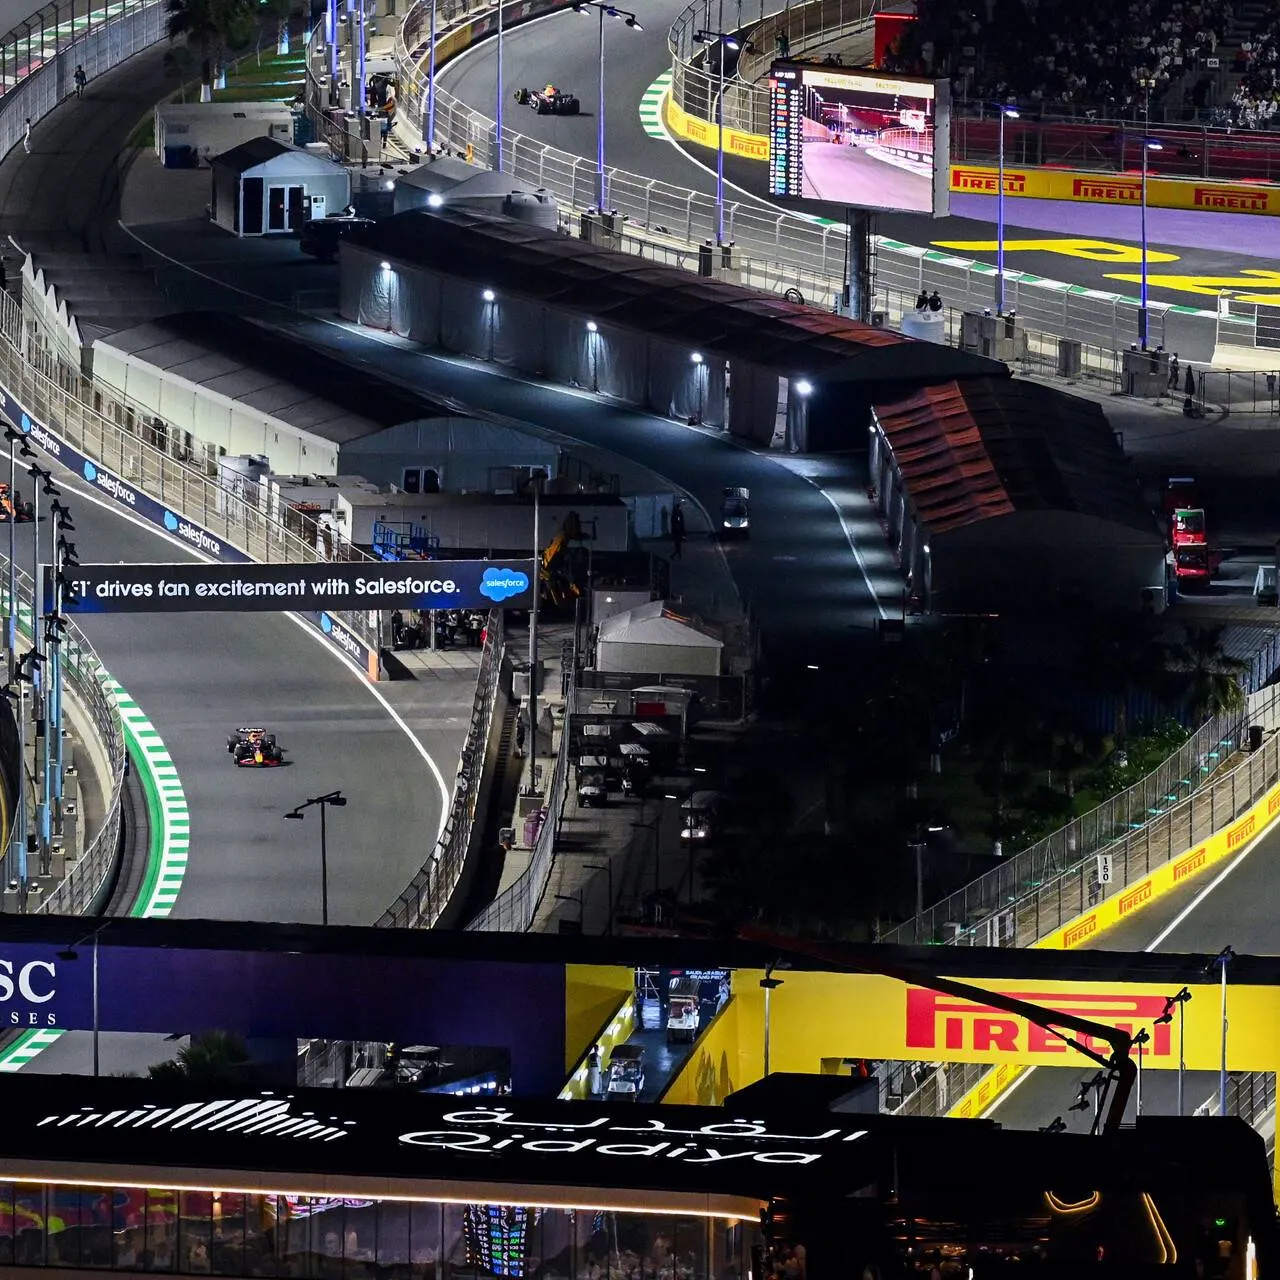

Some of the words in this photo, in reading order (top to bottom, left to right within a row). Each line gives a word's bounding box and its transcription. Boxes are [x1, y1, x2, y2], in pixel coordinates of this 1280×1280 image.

[686, 119, 707, 141] PIRELLI
[730, 133, 768, 156] PIRELLI
[951, 168, 1026, 193] PIRELLI
[1193, 186, 1268, 211] PIRELLI
[30, 424, 61, 456] salesforce
[96, 473, 136, 506] salesforce
[178, 520, 221, 556] salesforce
[96, 578, 153, 598] drives
[158, 578, 190, 598] fan
[195, 578, 295, 598] excitement
[298, 577, 349, 597] with
[354, 576, 461, 598] Salesforce.
[486, 578, 524, 589] salesforce
[330, 623, 361, 658] salesforce
[1227, 814, 1256, 849] PIRELLI
[1173, 847, 1207, 881] PIRELLI
[1119, 879, 1153, 915] PIRELLI
[1063, 913, 1097, 949] PIRELLI
[442, 1106, 869, 1144] القدية
[397, 1130, 823, 1166] Qiddiya
